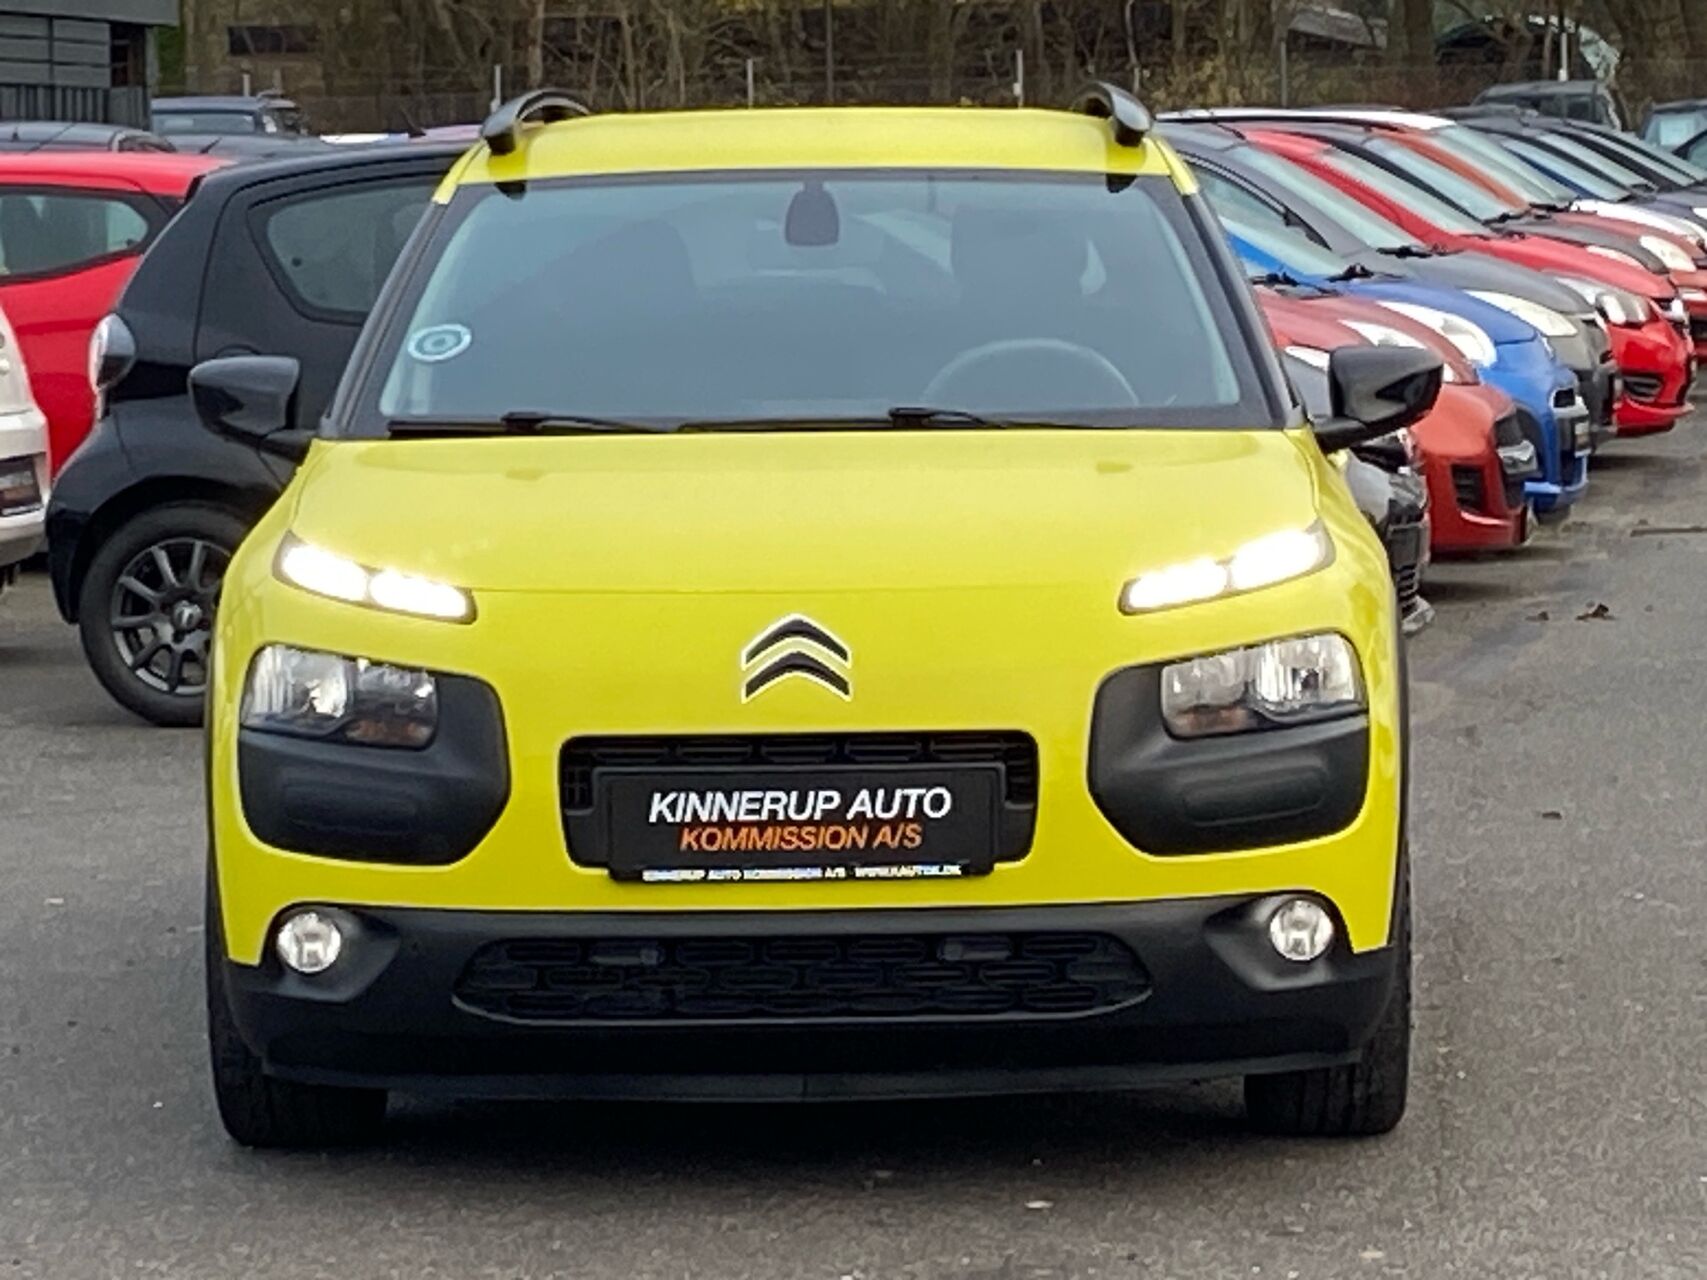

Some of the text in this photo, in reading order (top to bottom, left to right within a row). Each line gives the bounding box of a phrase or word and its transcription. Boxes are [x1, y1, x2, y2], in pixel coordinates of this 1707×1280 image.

[649, 787, 952, 823] KINNERUP AUTO
[680, 823, 923, 851] KOMMISSION A/S
